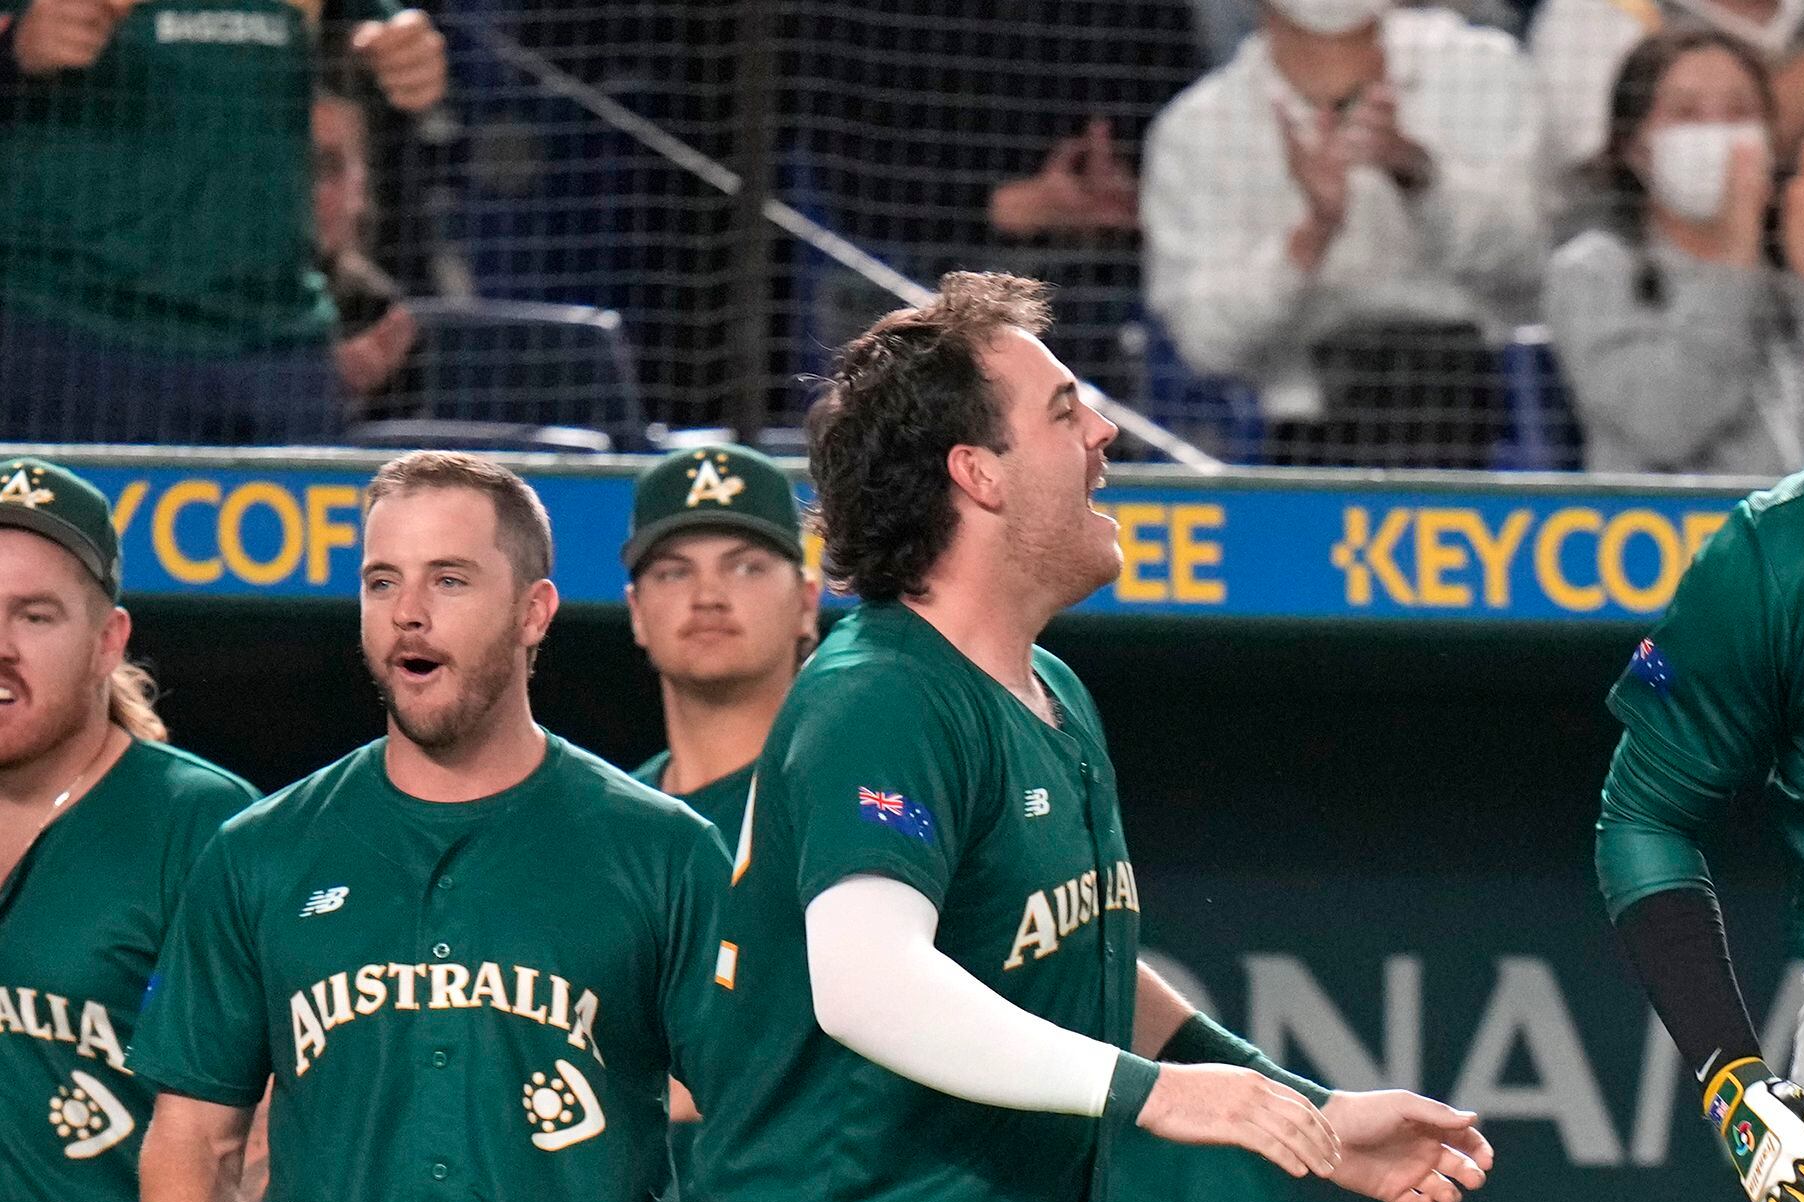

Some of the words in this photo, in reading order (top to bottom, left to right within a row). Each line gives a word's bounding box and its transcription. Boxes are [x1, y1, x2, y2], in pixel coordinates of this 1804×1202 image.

[113, 479, 373, 585] COF
[1092, 504, 1225, 603] EE
[290, 961, 606, 1077] AUSTRALIA
